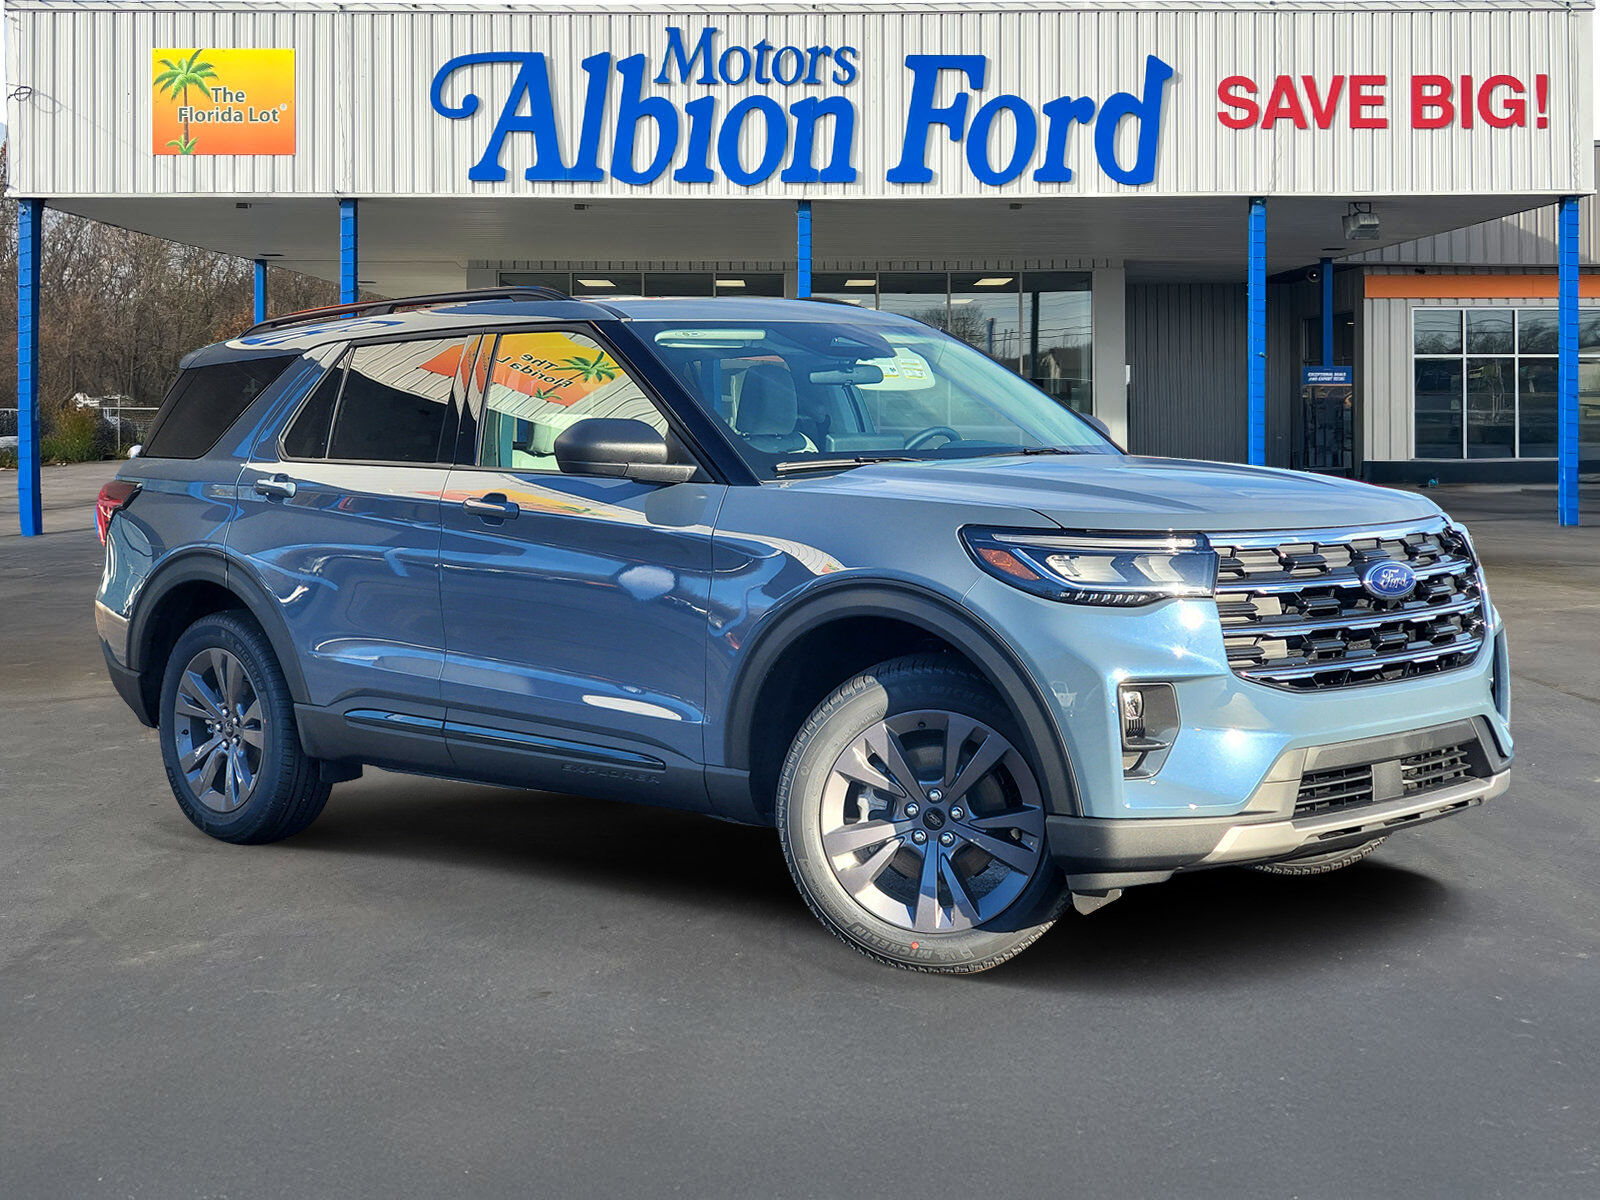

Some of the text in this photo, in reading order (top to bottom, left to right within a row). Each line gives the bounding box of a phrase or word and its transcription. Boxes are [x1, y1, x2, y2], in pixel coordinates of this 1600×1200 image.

[653, 26, 857, 85] Motors
[210, 86, 246, 103] The
[1217, 73, 1548, 129] SAVE BIG!
[177, 106, 244, 123] Florida
[430, 51, 1174, 186] Albion Ford
[1380, 568, 1408, 590] Ford
[850, 922, 934, 960] MICHELIN
